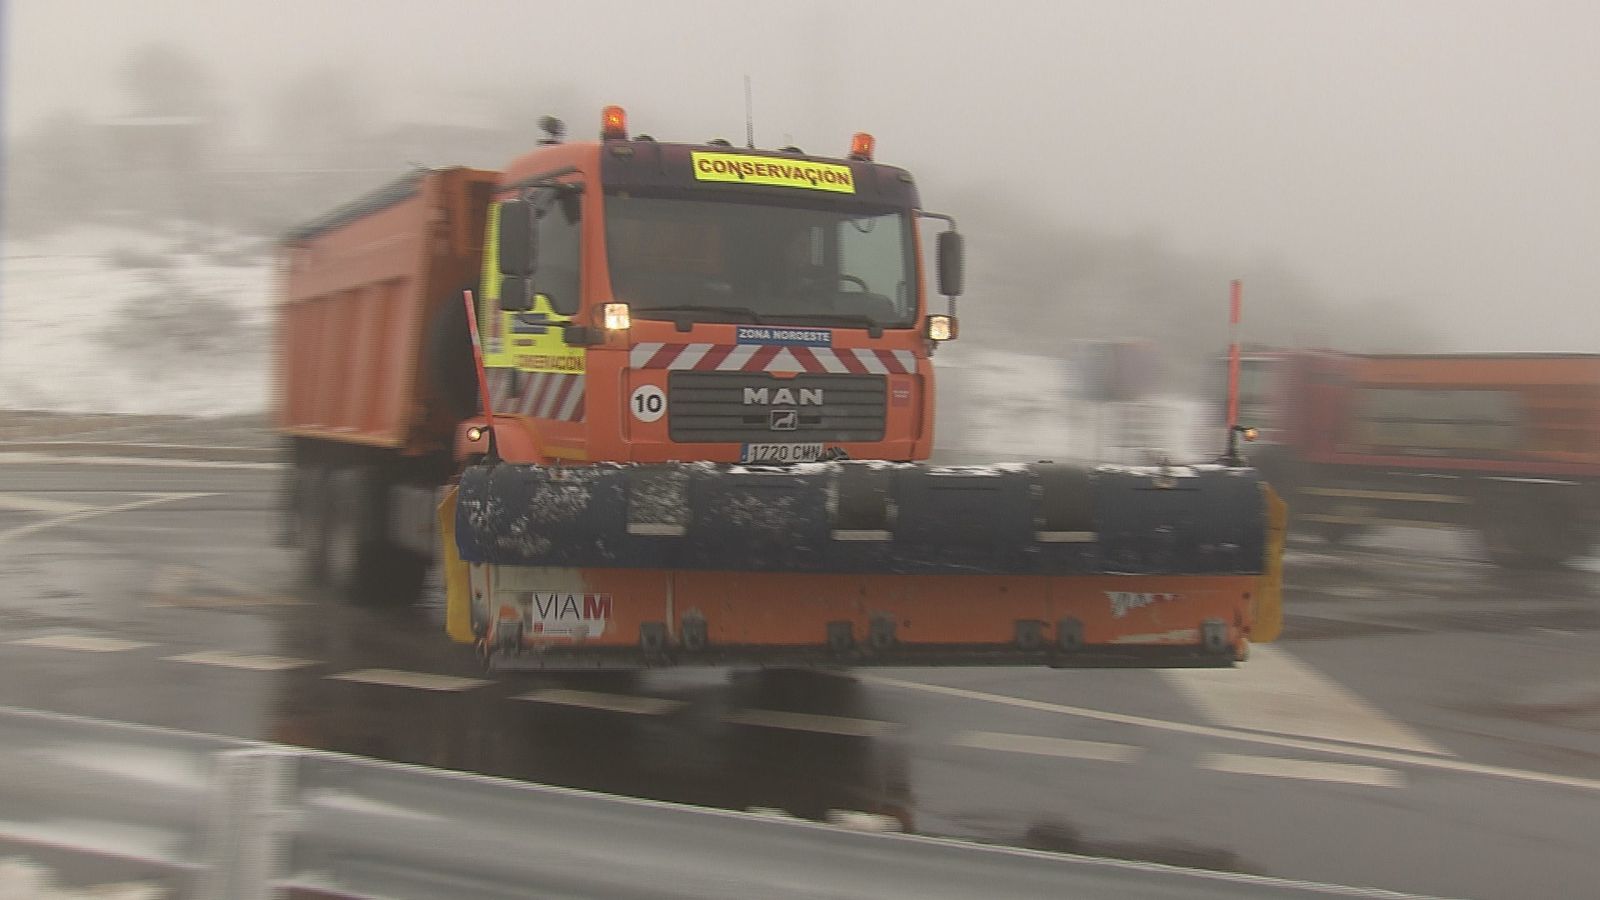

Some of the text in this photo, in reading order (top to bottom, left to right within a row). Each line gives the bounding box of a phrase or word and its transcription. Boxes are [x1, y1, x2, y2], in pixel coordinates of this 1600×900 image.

[699, 158, 851, 185] CONSERVACIÓN
[739, 328, 831, 342] ZONA NOROESTE
[634, 394, 663, 413] 10
[743, 387, 824, 405] MAN
[752, 445, 788, 460] 1720
[534, 594, 612, 620] VIAM
